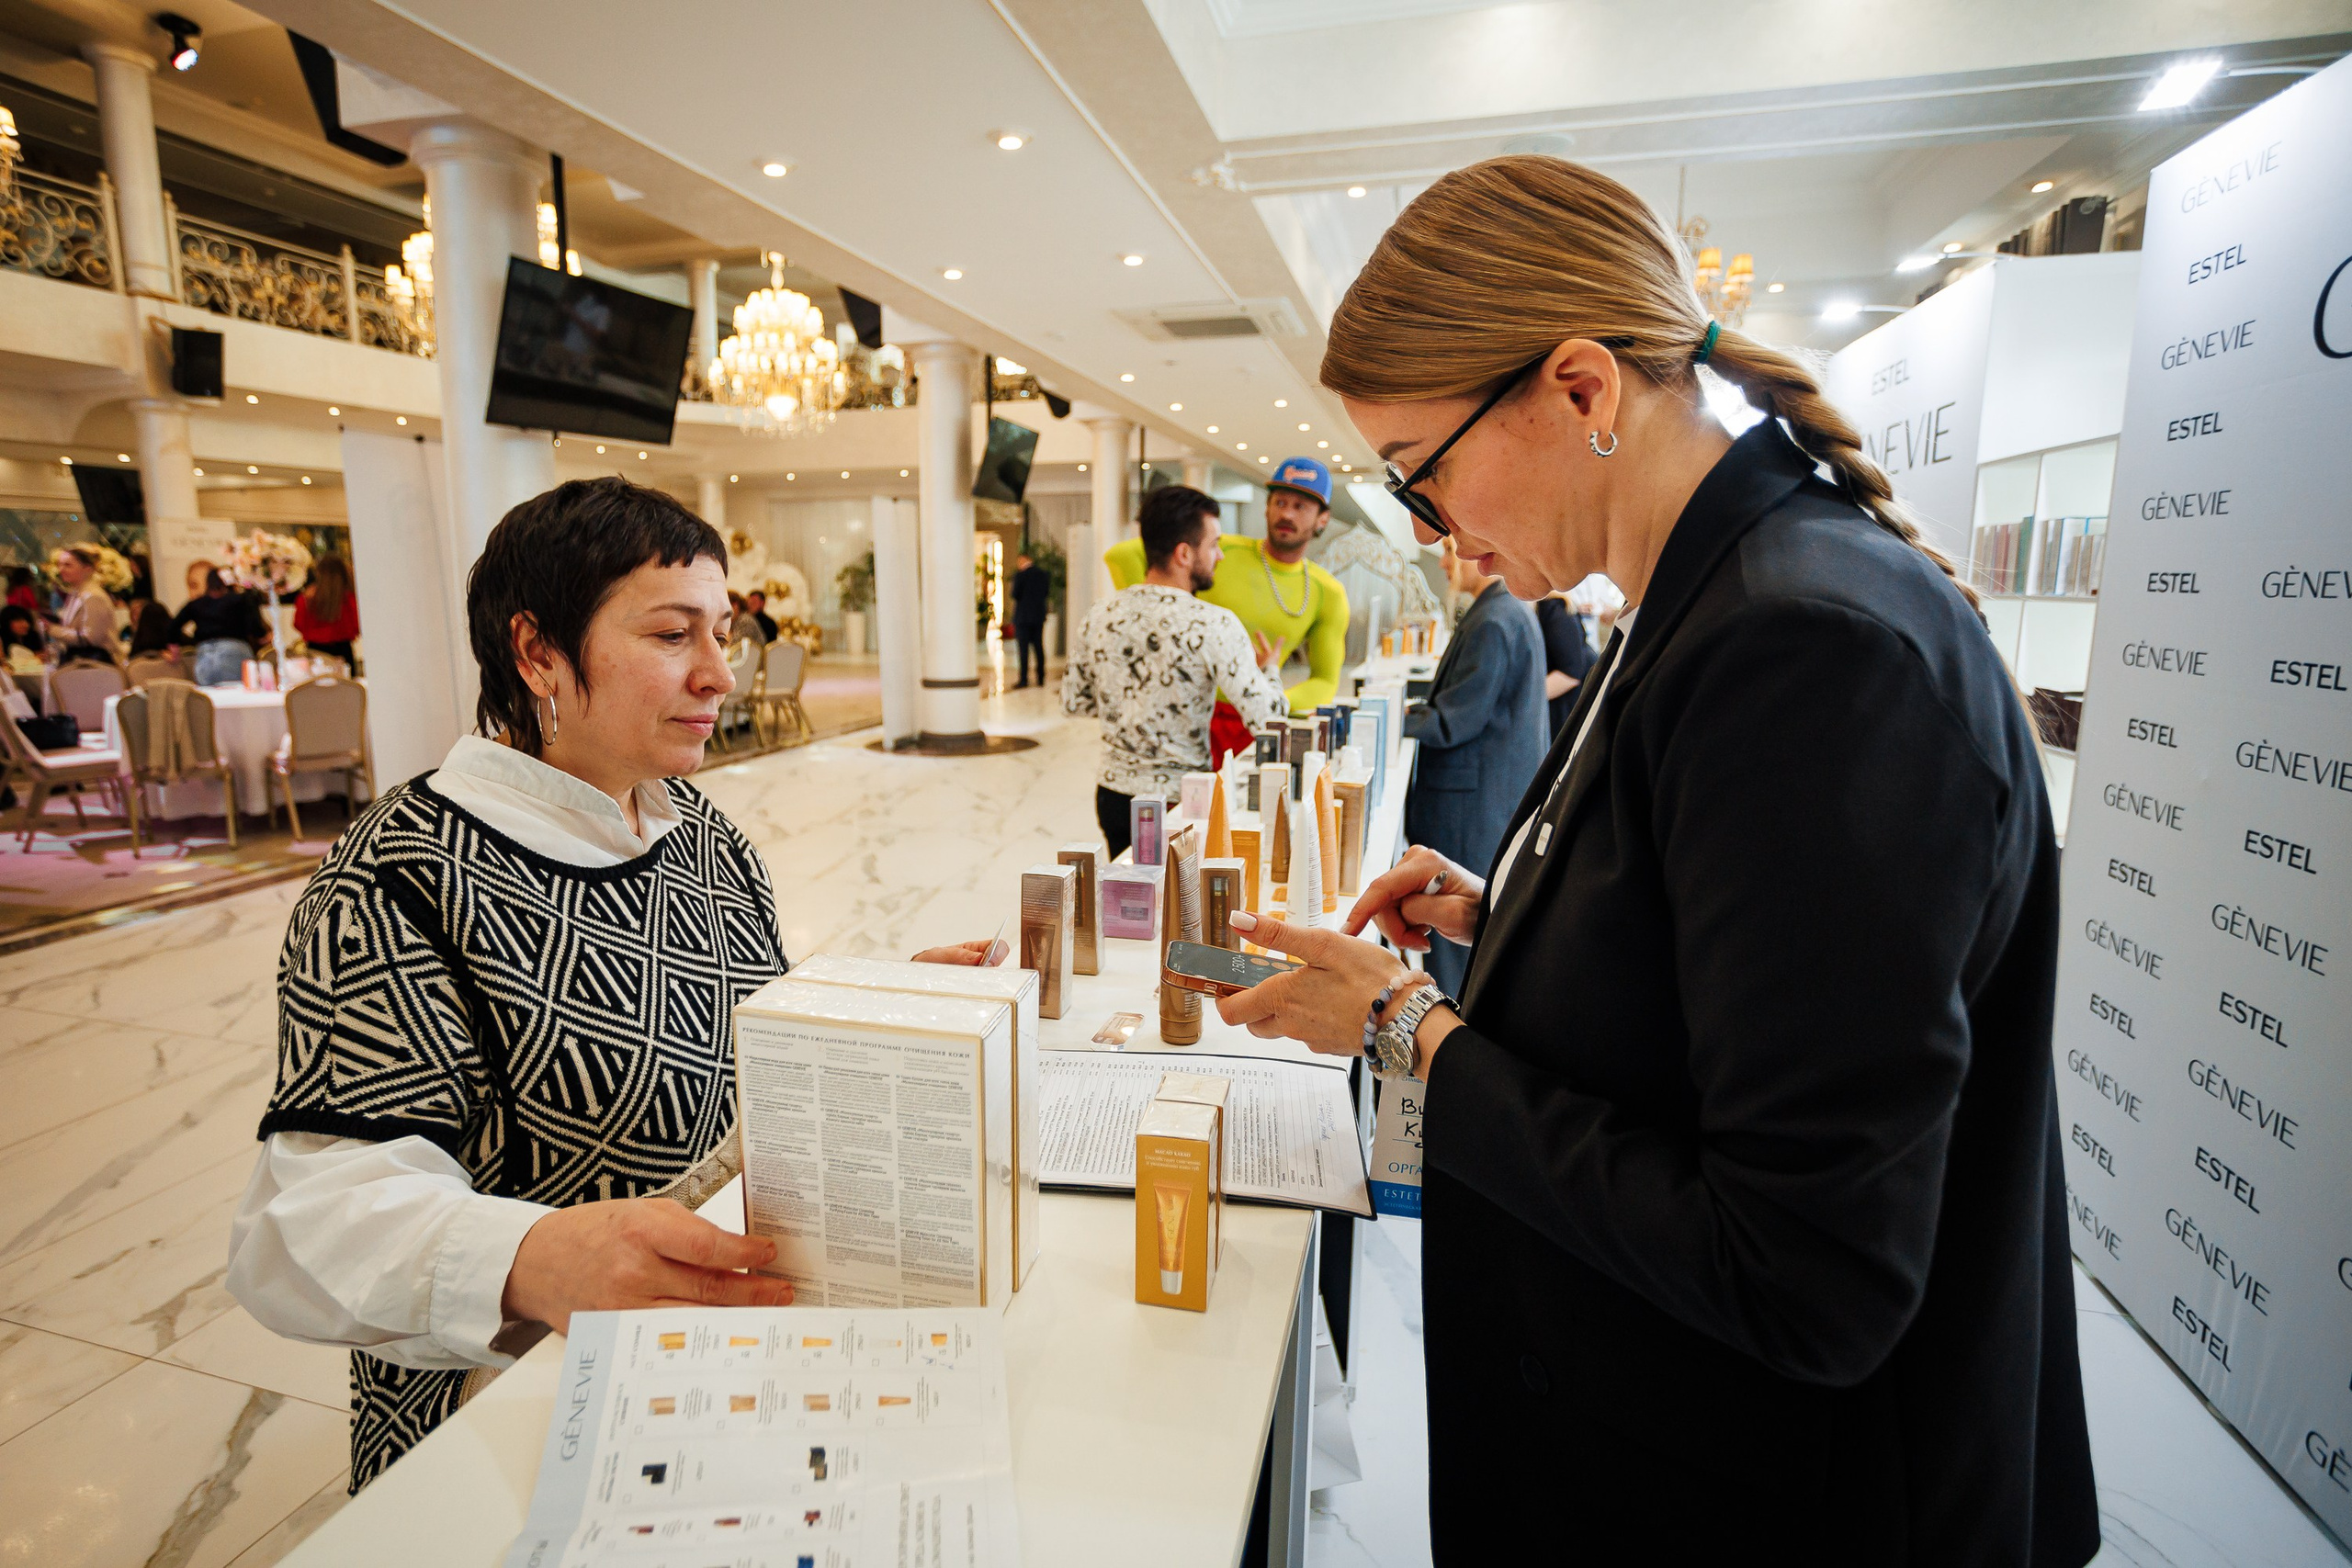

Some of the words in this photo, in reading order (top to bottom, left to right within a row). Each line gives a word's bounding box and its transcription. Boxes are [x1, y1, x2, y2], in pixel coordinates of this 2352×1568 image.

[2180, 140, 2283, 215] GÈNEVIE
[2188, 243, 2247, 286] ESTEL
[2161, 319, 2256, 371] GÈNEVIE
[1871, 358, 1911, 396] ESTEL
[1862, 401, 1956, 476] NEVIE
[2166, 411, 2224, 442] ESTEL
[2141, 489, 2233, 522] GÈNEVIE
[2146, 572, 2201, 594] ESTEL
[2121, 640, 2209, 677] GÈNEVIE
[2269, 659, 2349, 692] ESTEL
[2126, 717, 2178, 749] ESTEL
[2102, 783, 2186, 832] GÈNEVIE
[2244, 829, 2317, 875] ESTEL
[2107, 858, 2157, 897] ESTEL
[2084, 919, 2164, 981] GÈNEVIE
[2211, 903, 2330, 977] GÈNEVIE
[742, 1026, 797, 1039] РЕКОМЕНДАЦИИ
[810, 1035, 858, 1046] ЕЖЕДНЕВНОЙ
[859, 1042, 901, 1052] ПРОГРАММЕ
[903, 1046, 946, 1056] ОЧИЩЕНИЯ
[2088, 992, 2137, 1041] ESTEL
[2218, 990, 2290, 1049] ESTEL
[2067, 1047, 2143, 1124] GÈNEVIE
[2188, 1059, 2300, 1151] GÈNEVIE
[2071, 1122, 2117, 1179] ESTEL
[2194, 1145, 2261, 1214] ESTEL
[2165, 1207, 2271, 1317] GÈNEVIE
[2171, 1295, 2233, 1373] ESTEL
[560, 1348, 598, 1462] GÈNEVIE
